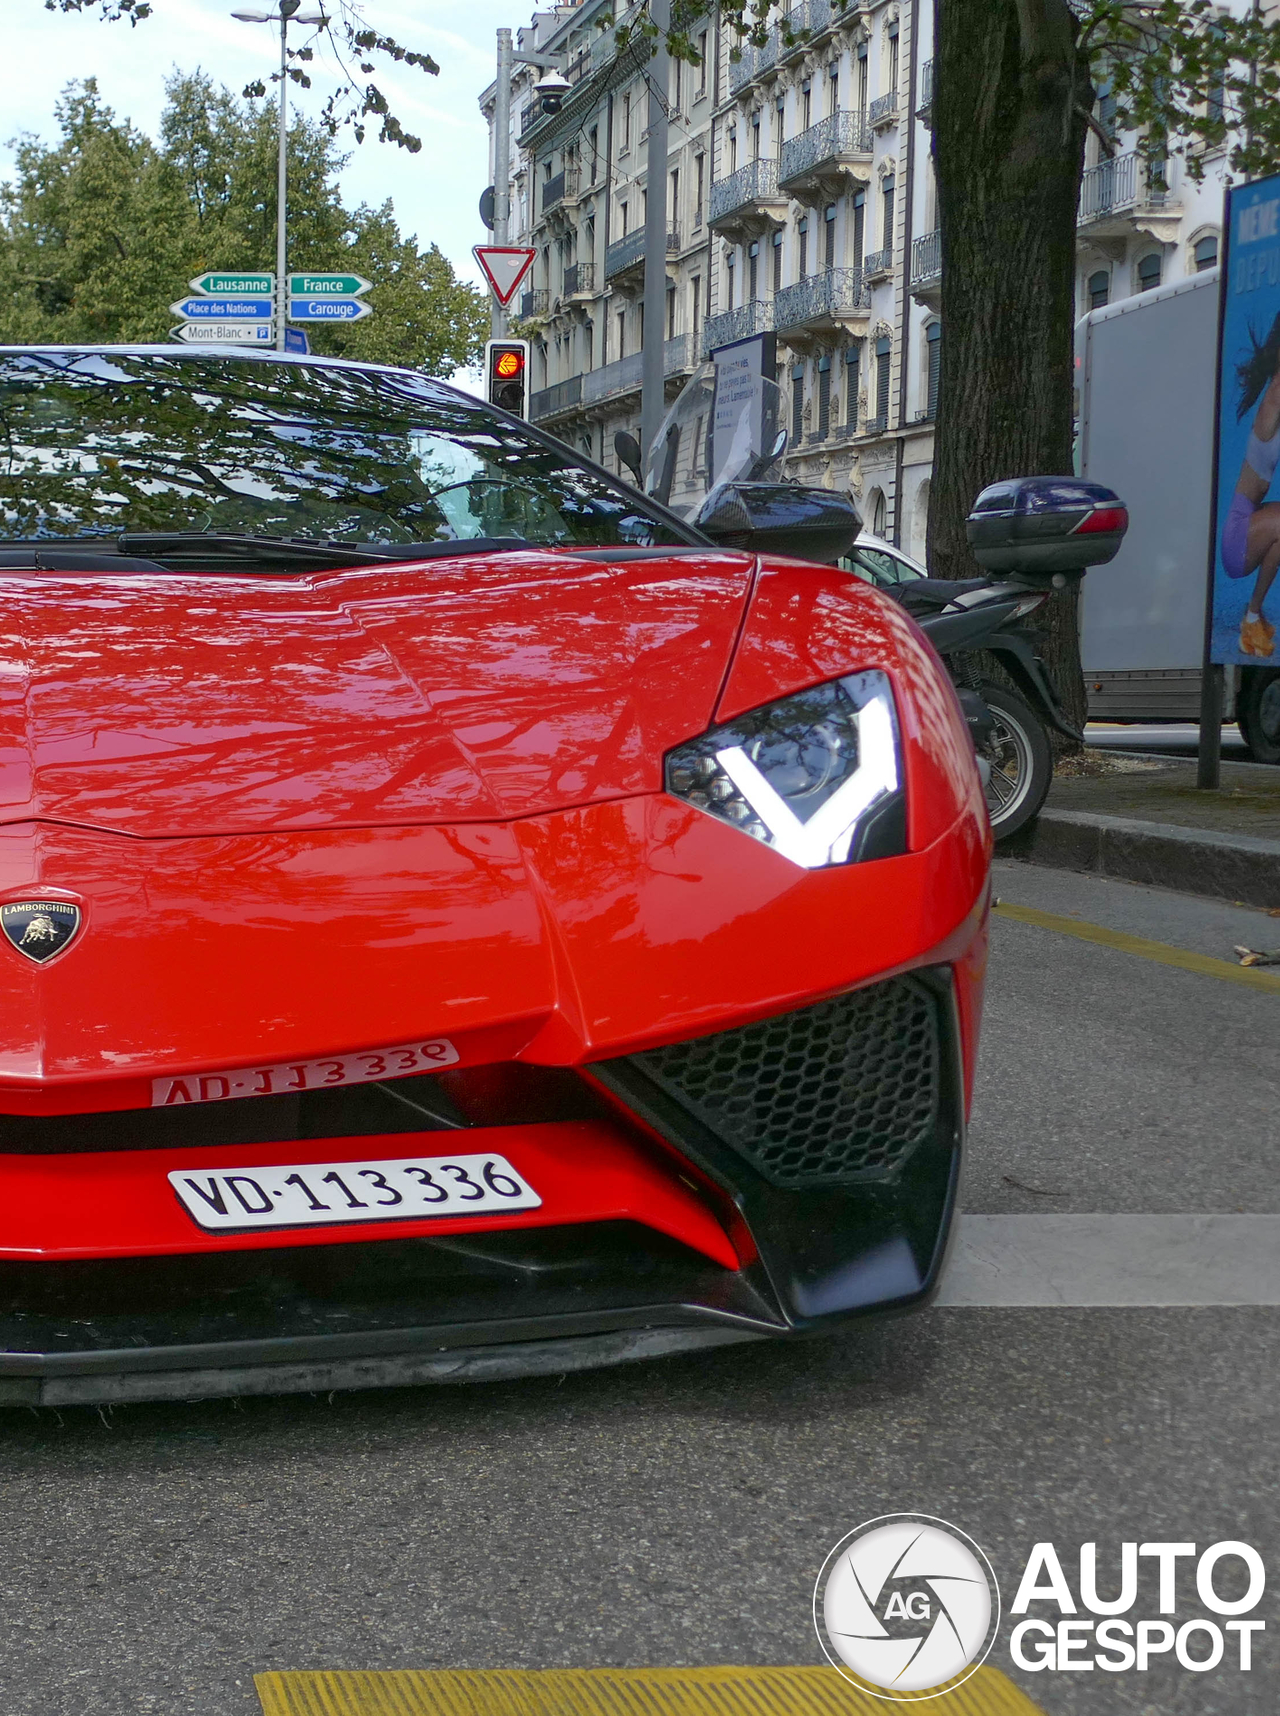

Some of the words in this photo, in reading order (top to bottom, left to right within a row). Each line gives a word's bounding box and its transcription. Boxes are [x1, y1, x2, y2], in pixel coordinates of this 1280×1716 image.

[209, 278, 268, 291] Lausanne
[304, 278, 343, 291] France
[188, 303, 209, 314] Place
[211, 304, 225, 314] des
[226, 304, 257, 314] Nations
[308, 302, 354, 318] Carouge
[188, 325, 242, 339] Mont-Blanc
[4, 903, 74, 915] LAMBORGHINI
